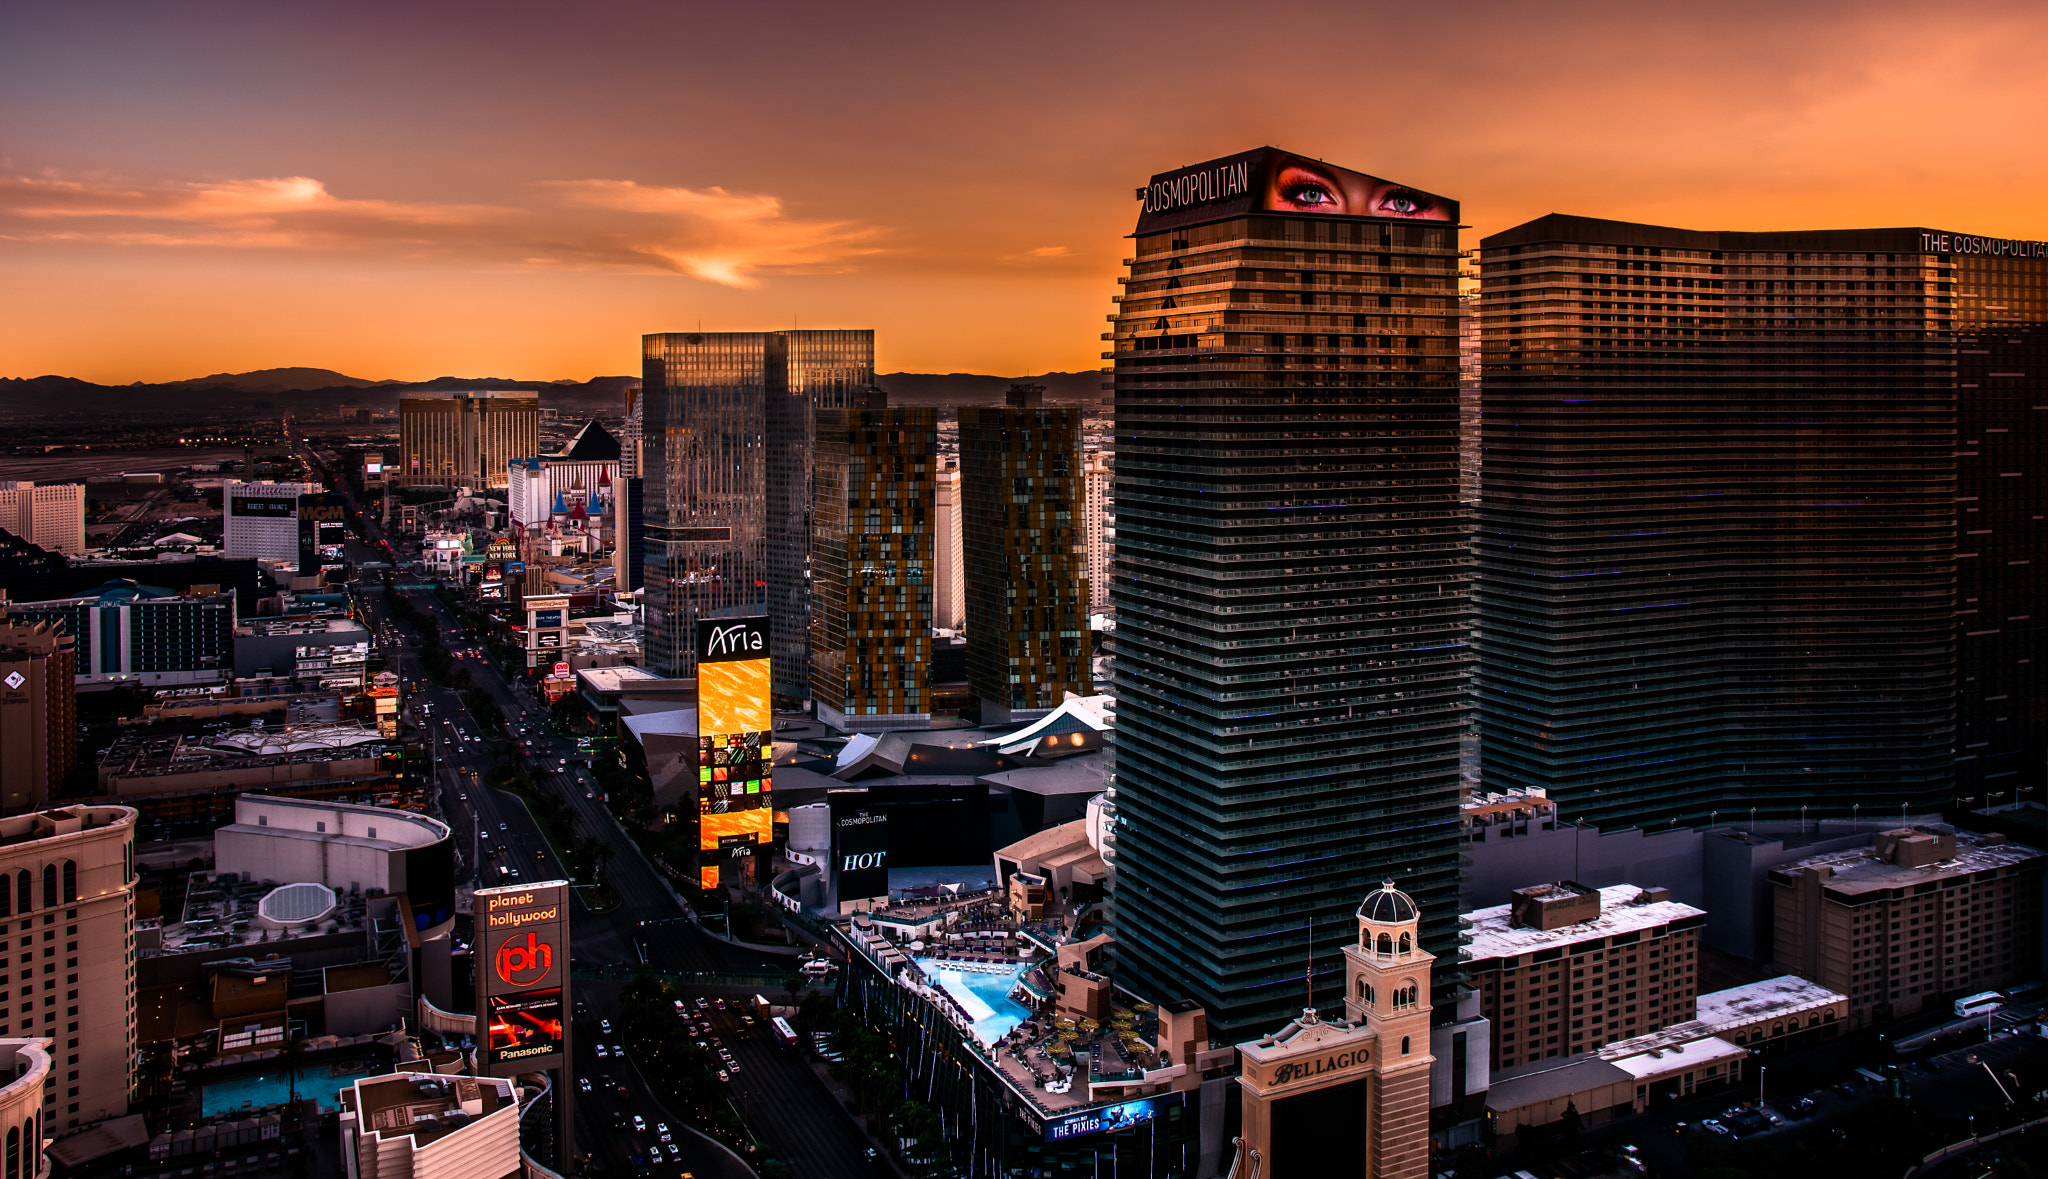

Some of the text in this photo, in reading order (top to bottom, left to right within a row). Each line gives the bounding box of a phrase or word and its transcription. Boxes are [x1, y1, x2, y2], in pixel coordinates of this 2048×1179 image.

[1145, 161, 1248, 213] COSMOPOLITAN
[1922, 233, 2048, 258] THE COSMOPOLITA
[298, 506, 345, 520] MGM
[707, 624, 763, 657] Aria
[841, 814, 887, 827] COSMOPOLITAN
[731, 846, 751, 858] Aria
[842, 851, 886, 872] HOT
[489, 893, 533, 912] planet
[489, 907, 556, 927] hollywood
[502, 932, 552, 984] ph
[500, 1044, 553, 1060] Panasonic
[1268, 1049, 1369, 1086] BELLAGIO
[1019, 1107, 1027, 1122] THE
[1053, 1124, 1069, 1138] THE
[1072, 1118, 1100, 1134] PIXIES
